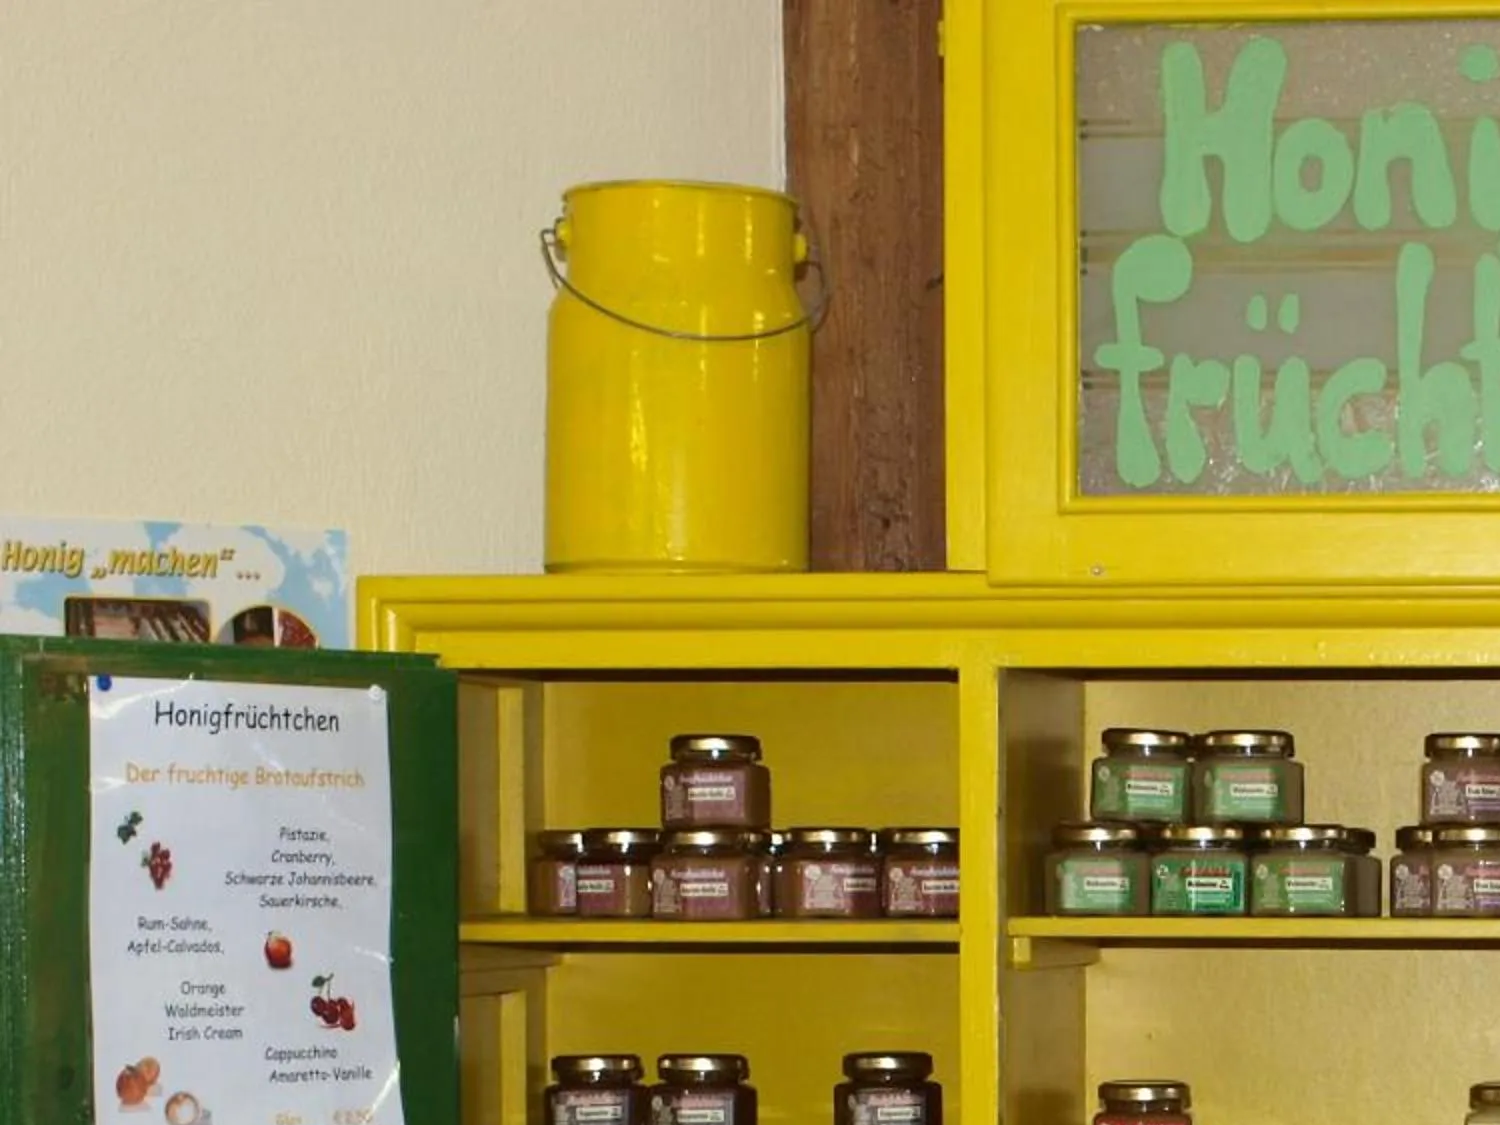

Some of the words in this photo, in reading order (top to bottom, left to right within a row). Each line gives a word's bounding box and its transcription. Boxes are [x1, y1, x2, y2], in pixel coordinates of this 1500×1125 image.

[1, 539, 84, 578] Honig
[155, 700, 340, 737] Honigfrüchtchen
[126, 762, 160, 784] Der
[167, 762, 249, 791] fruchtige
[255, 765, 365, 790] Brotaufstrich
